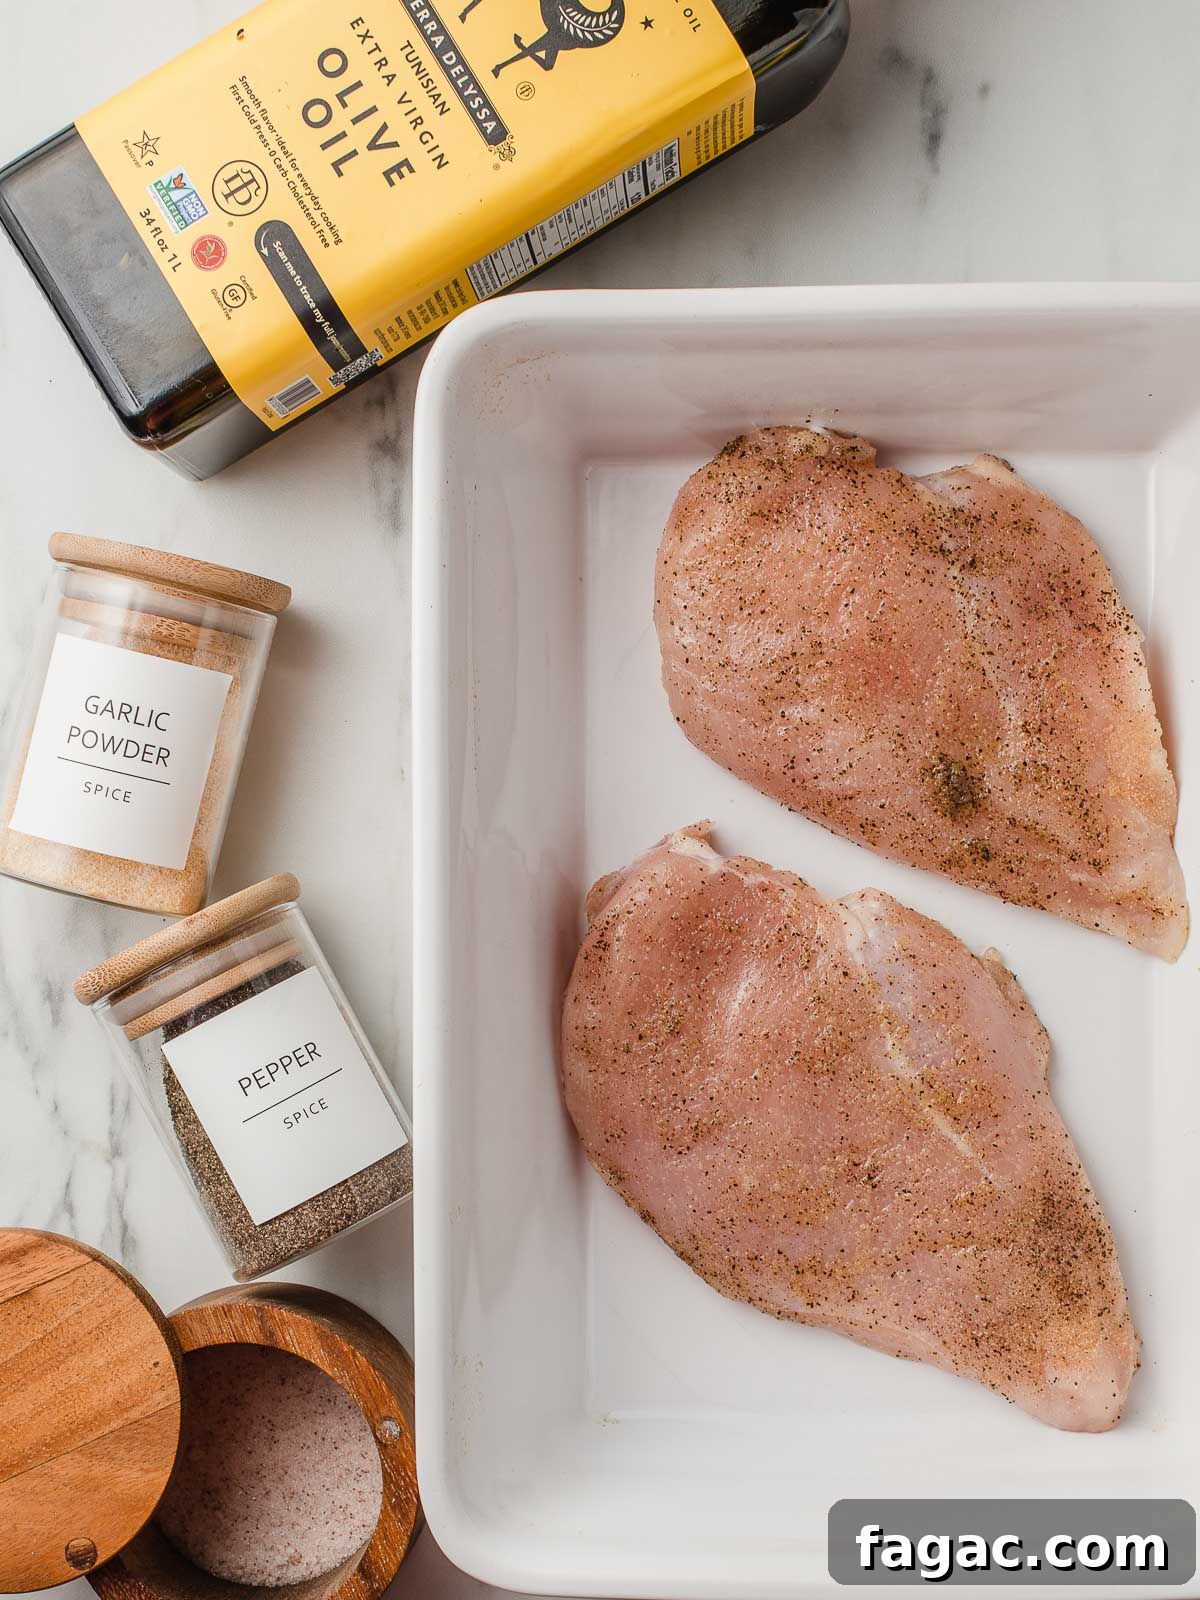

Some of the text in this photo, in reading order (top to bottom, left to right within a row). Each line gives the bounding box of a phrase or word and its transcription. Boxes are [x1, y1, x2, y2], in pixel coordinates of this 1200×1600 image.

[683, 8, 701, 33] OIL
[349, 16, 450, 170] EXTRA VIRGIN
[399, 39, 451, 117] TUNISIAN
[441, 50, 497, 135] DELYSSA
[301, 97, 359, 179] OIL
[317, 47, 416, 188] OLIVE
[122, 138, 142, 169] Passover
[144, 159, 154, 167] P
[229, 84, 245, 105] First
[241, 104, 258, 125] Cold
[253, 124, 270, 149] Press
[273, 157, 289, 178] Carb
[287, 180, 321, 230] Cholesterol
[315, 228, 330, 249] Free
[238, 75, 343, 246] Smooth flavor Ideal for everyday cooking
[155, 181, 186, 229] VERIFIED
[182, 197, 200, 221] GMO
[188, 192, 207, 218] NON
[139, 207, 182, 273] 34 fl oz 1 L
[228, 288, 241, 302] GF
[239, 274, 258, 301] Certified
[272, 240, 335, 337] Scan me to trace my full
[84, 694, 171, 732] GARLIC
[66, 725, 172, 768] POWDER
[82, 781, 133, 804] SPICE
[237, 1040, 323, 1097] PEPPER
[282, 1096, 329, 1130] SPICE
